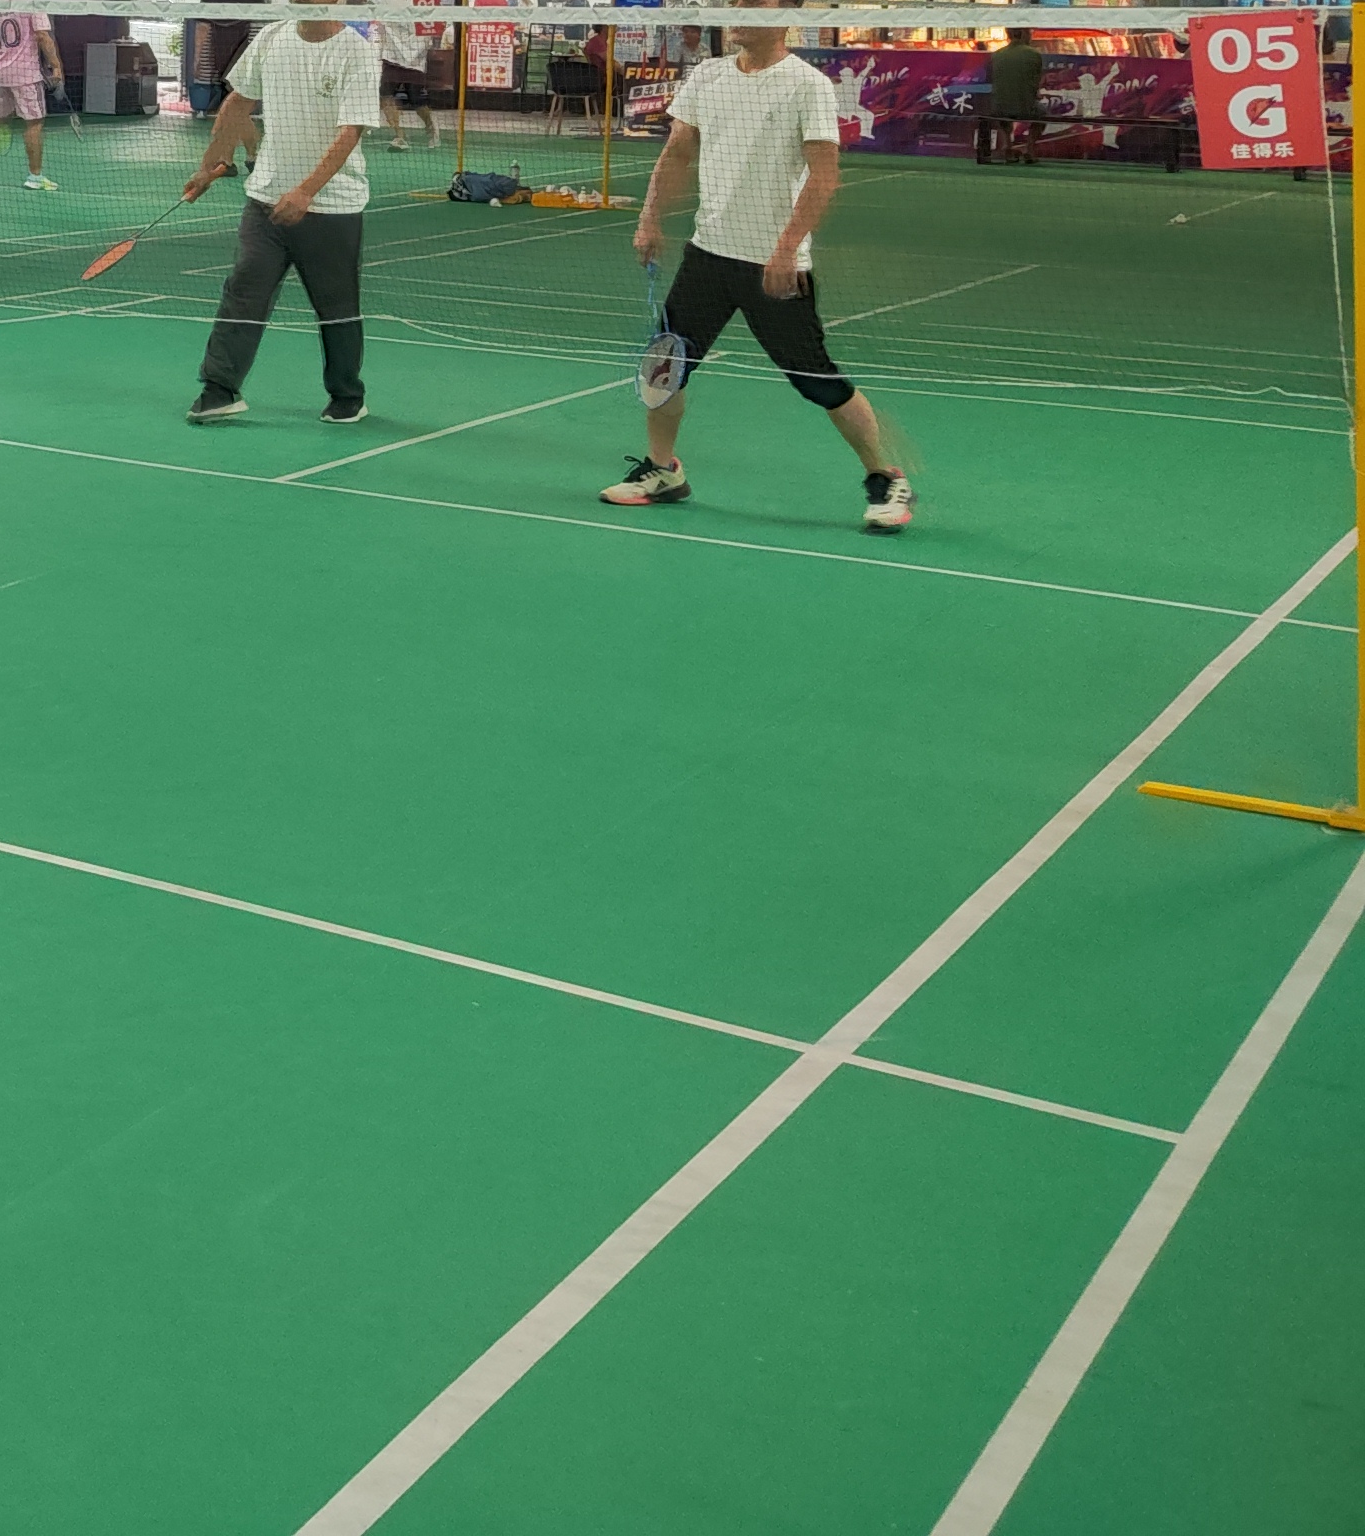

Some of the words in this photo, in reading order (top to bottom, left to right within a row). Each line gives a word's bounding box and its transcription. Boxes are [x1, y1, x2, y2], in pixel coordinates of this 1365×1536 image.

[1207, 25, 1300, 74] 05
[926, 82, 974, 114] 武术
[1228, 84, 1288, 138] G
[1230, 141, 1295, 159] 佳得乐
